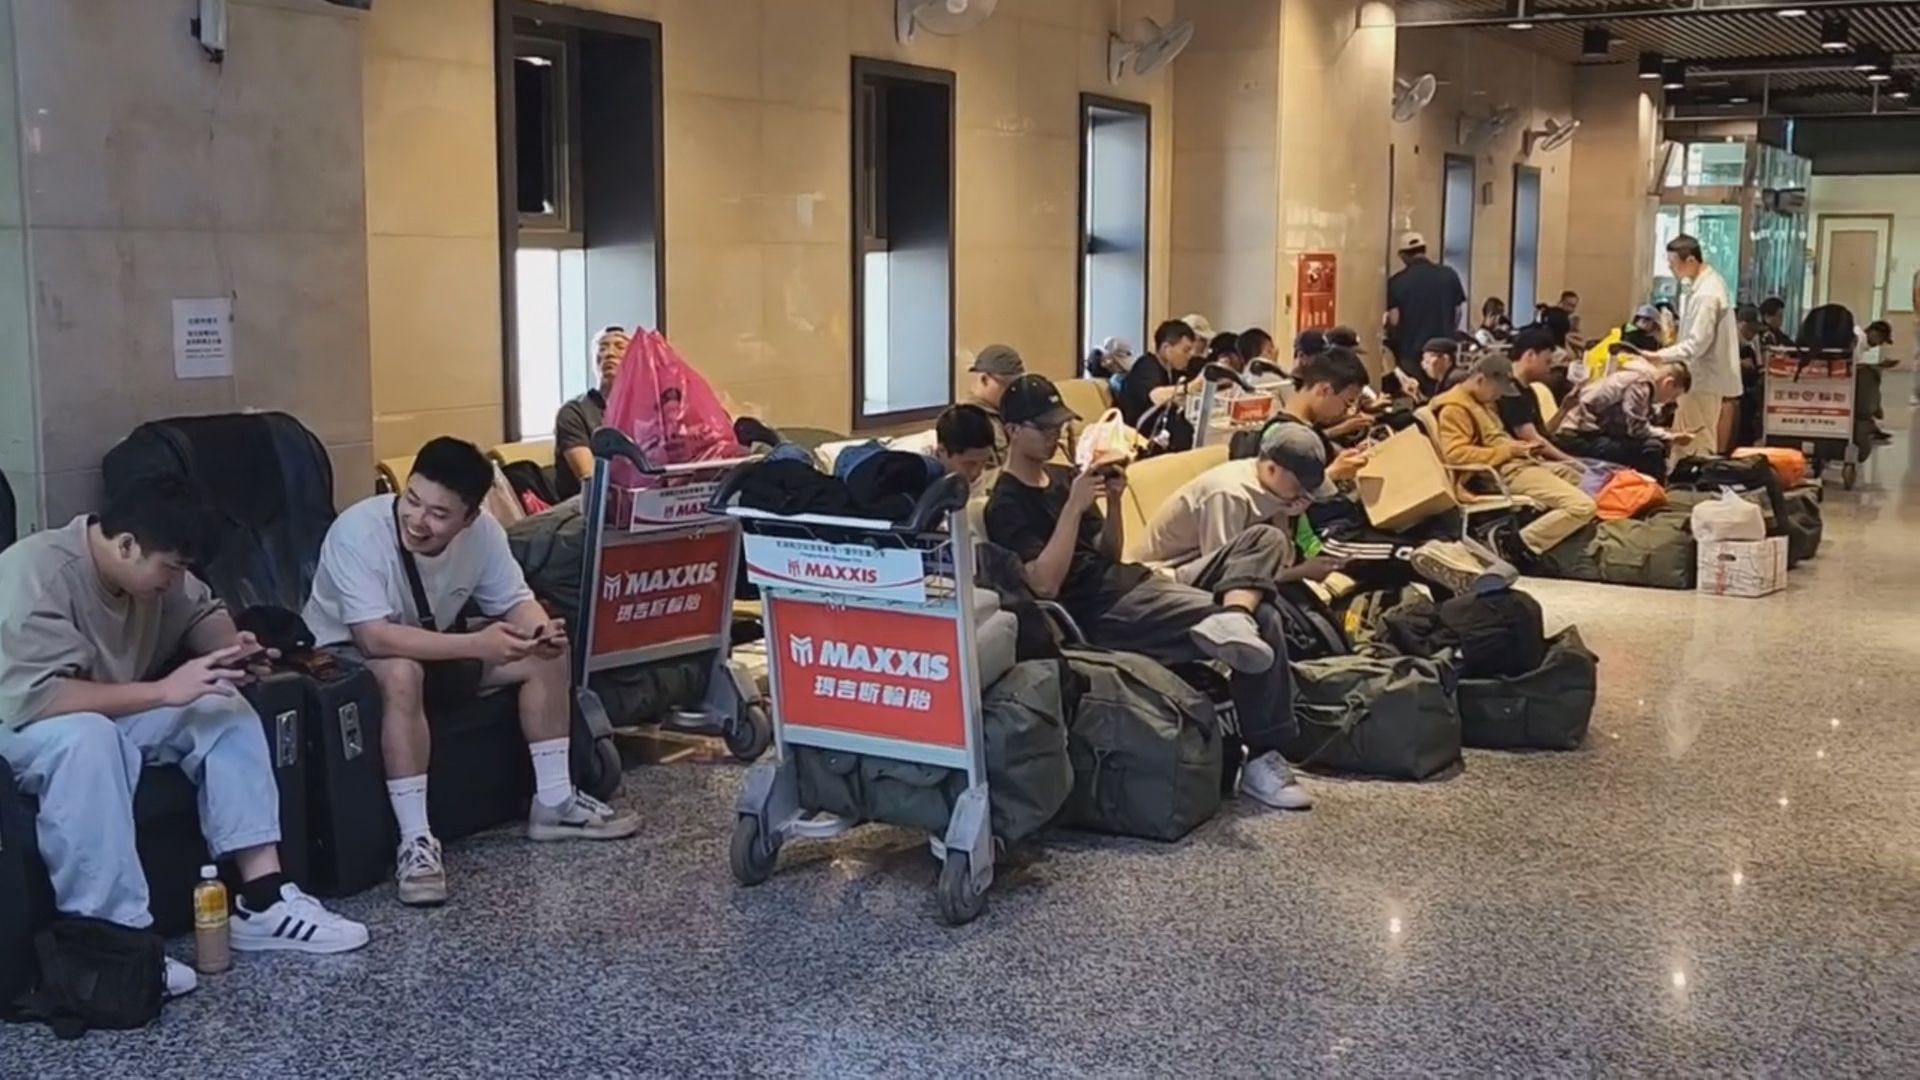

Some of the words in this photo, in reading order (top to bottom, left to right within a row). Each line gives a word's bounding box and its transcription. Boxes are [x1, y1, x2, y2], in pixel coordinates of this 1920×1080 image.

[624, 561, 718, 596] MAXXIS
[804, 562, 878, 584] MAXXIS
[819, 640, 950, 682] MAXXIS
[813, 675, 932, 712] 瑪吉斯輪胎
